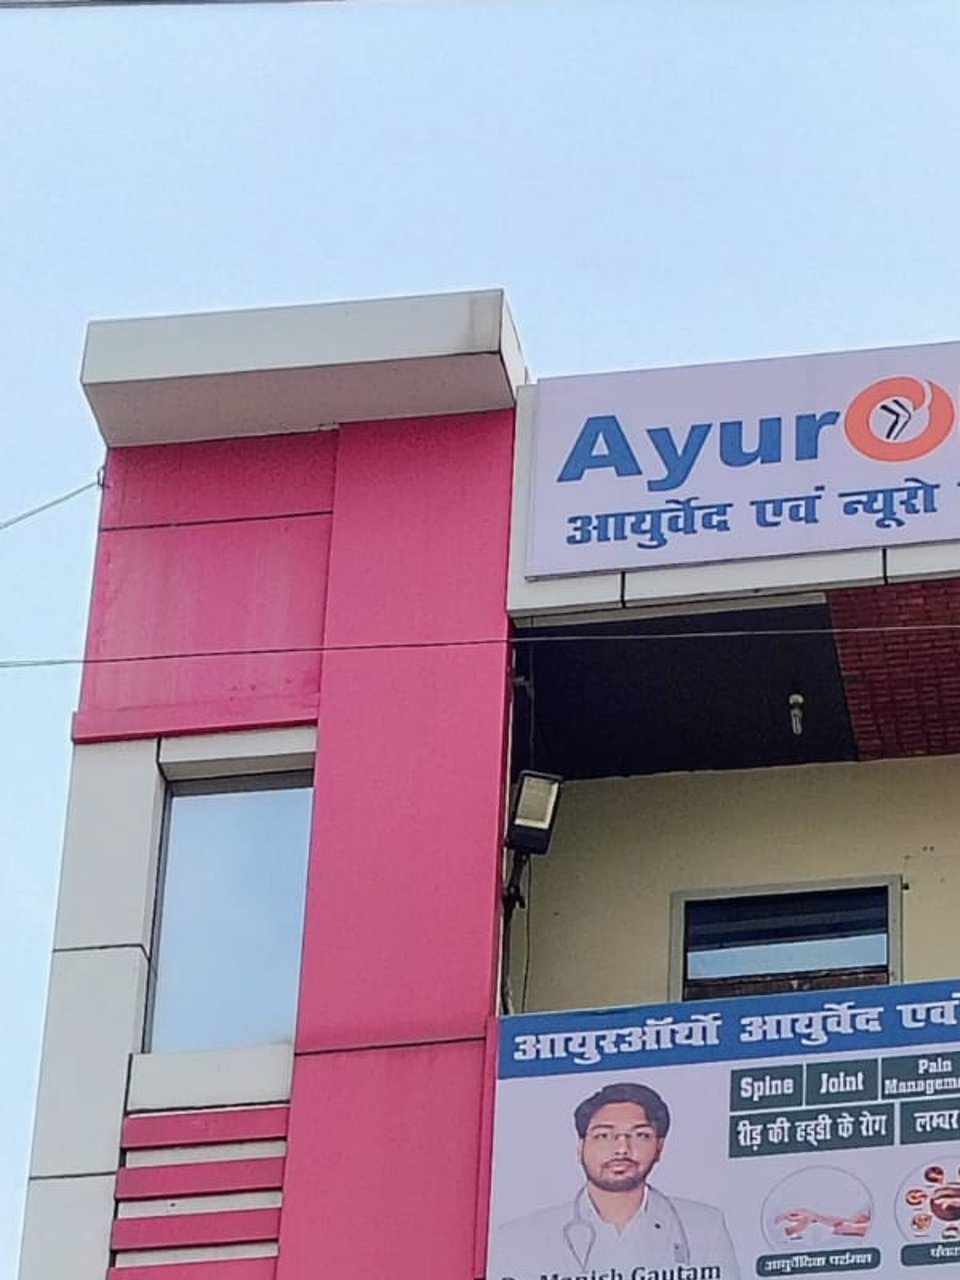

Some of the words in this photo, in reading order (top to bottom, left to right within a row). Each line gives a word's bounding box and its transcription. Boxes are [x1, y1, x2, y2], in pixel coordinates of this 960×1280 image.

[566, 497, 734, 549] आयुर्वेद
[749, 485, 826, 528] एवं
[838, 477, 940, 529] न्यूरो
[740, 1002, 884, 1045] आयुर्वेद
[918, 1057, 952, 1075] Pain
[740, 1075, 794, 1101] Spine
[819, 1072, 865, 1094] Joint
[767, 1117, 791, 1143] की
[837, 1112, 855, 1138] के
[859, 1110, 888, 1137] रोग
